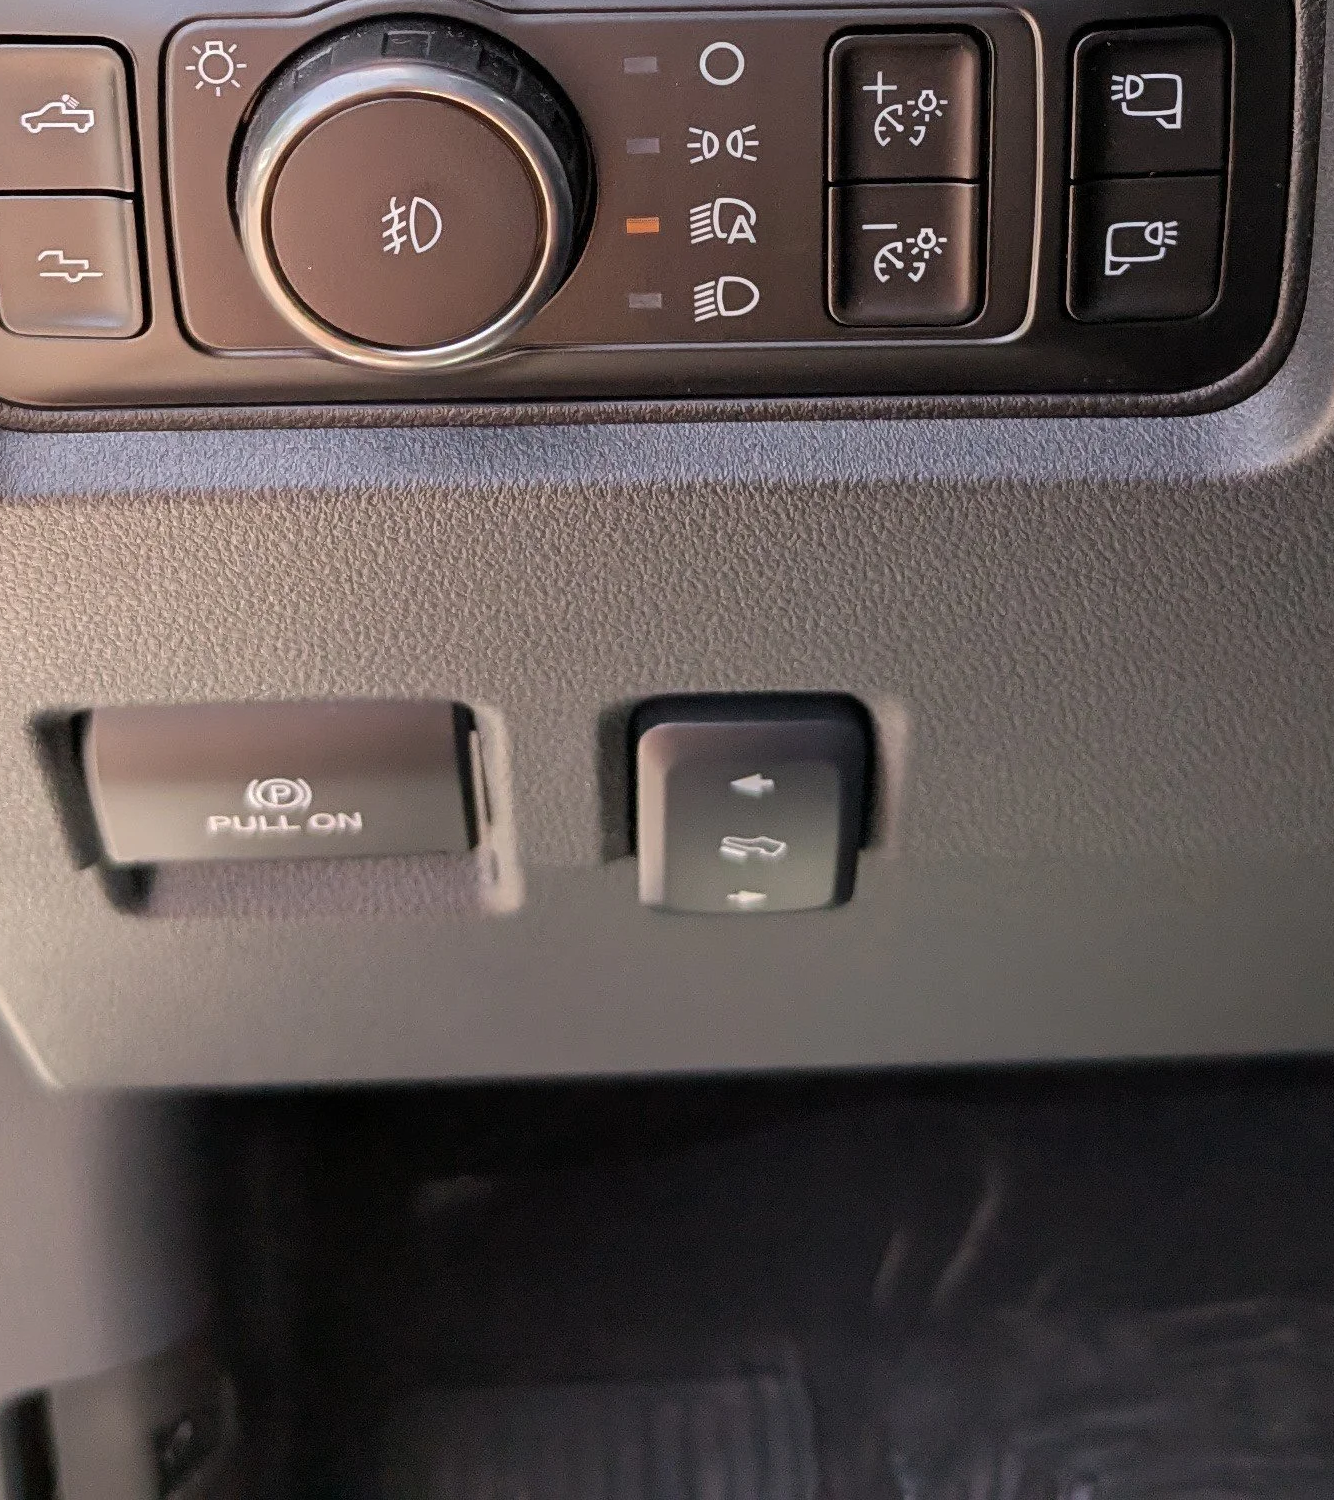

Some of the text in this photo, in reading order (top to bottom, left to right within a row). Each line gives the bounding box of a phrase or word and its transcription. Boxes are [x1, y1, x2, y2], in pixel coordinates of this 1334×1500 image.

[727, 215, 756, 244] A
[269, 784, 292, 805] P
[207, 811, 363, 835] PULL ON
